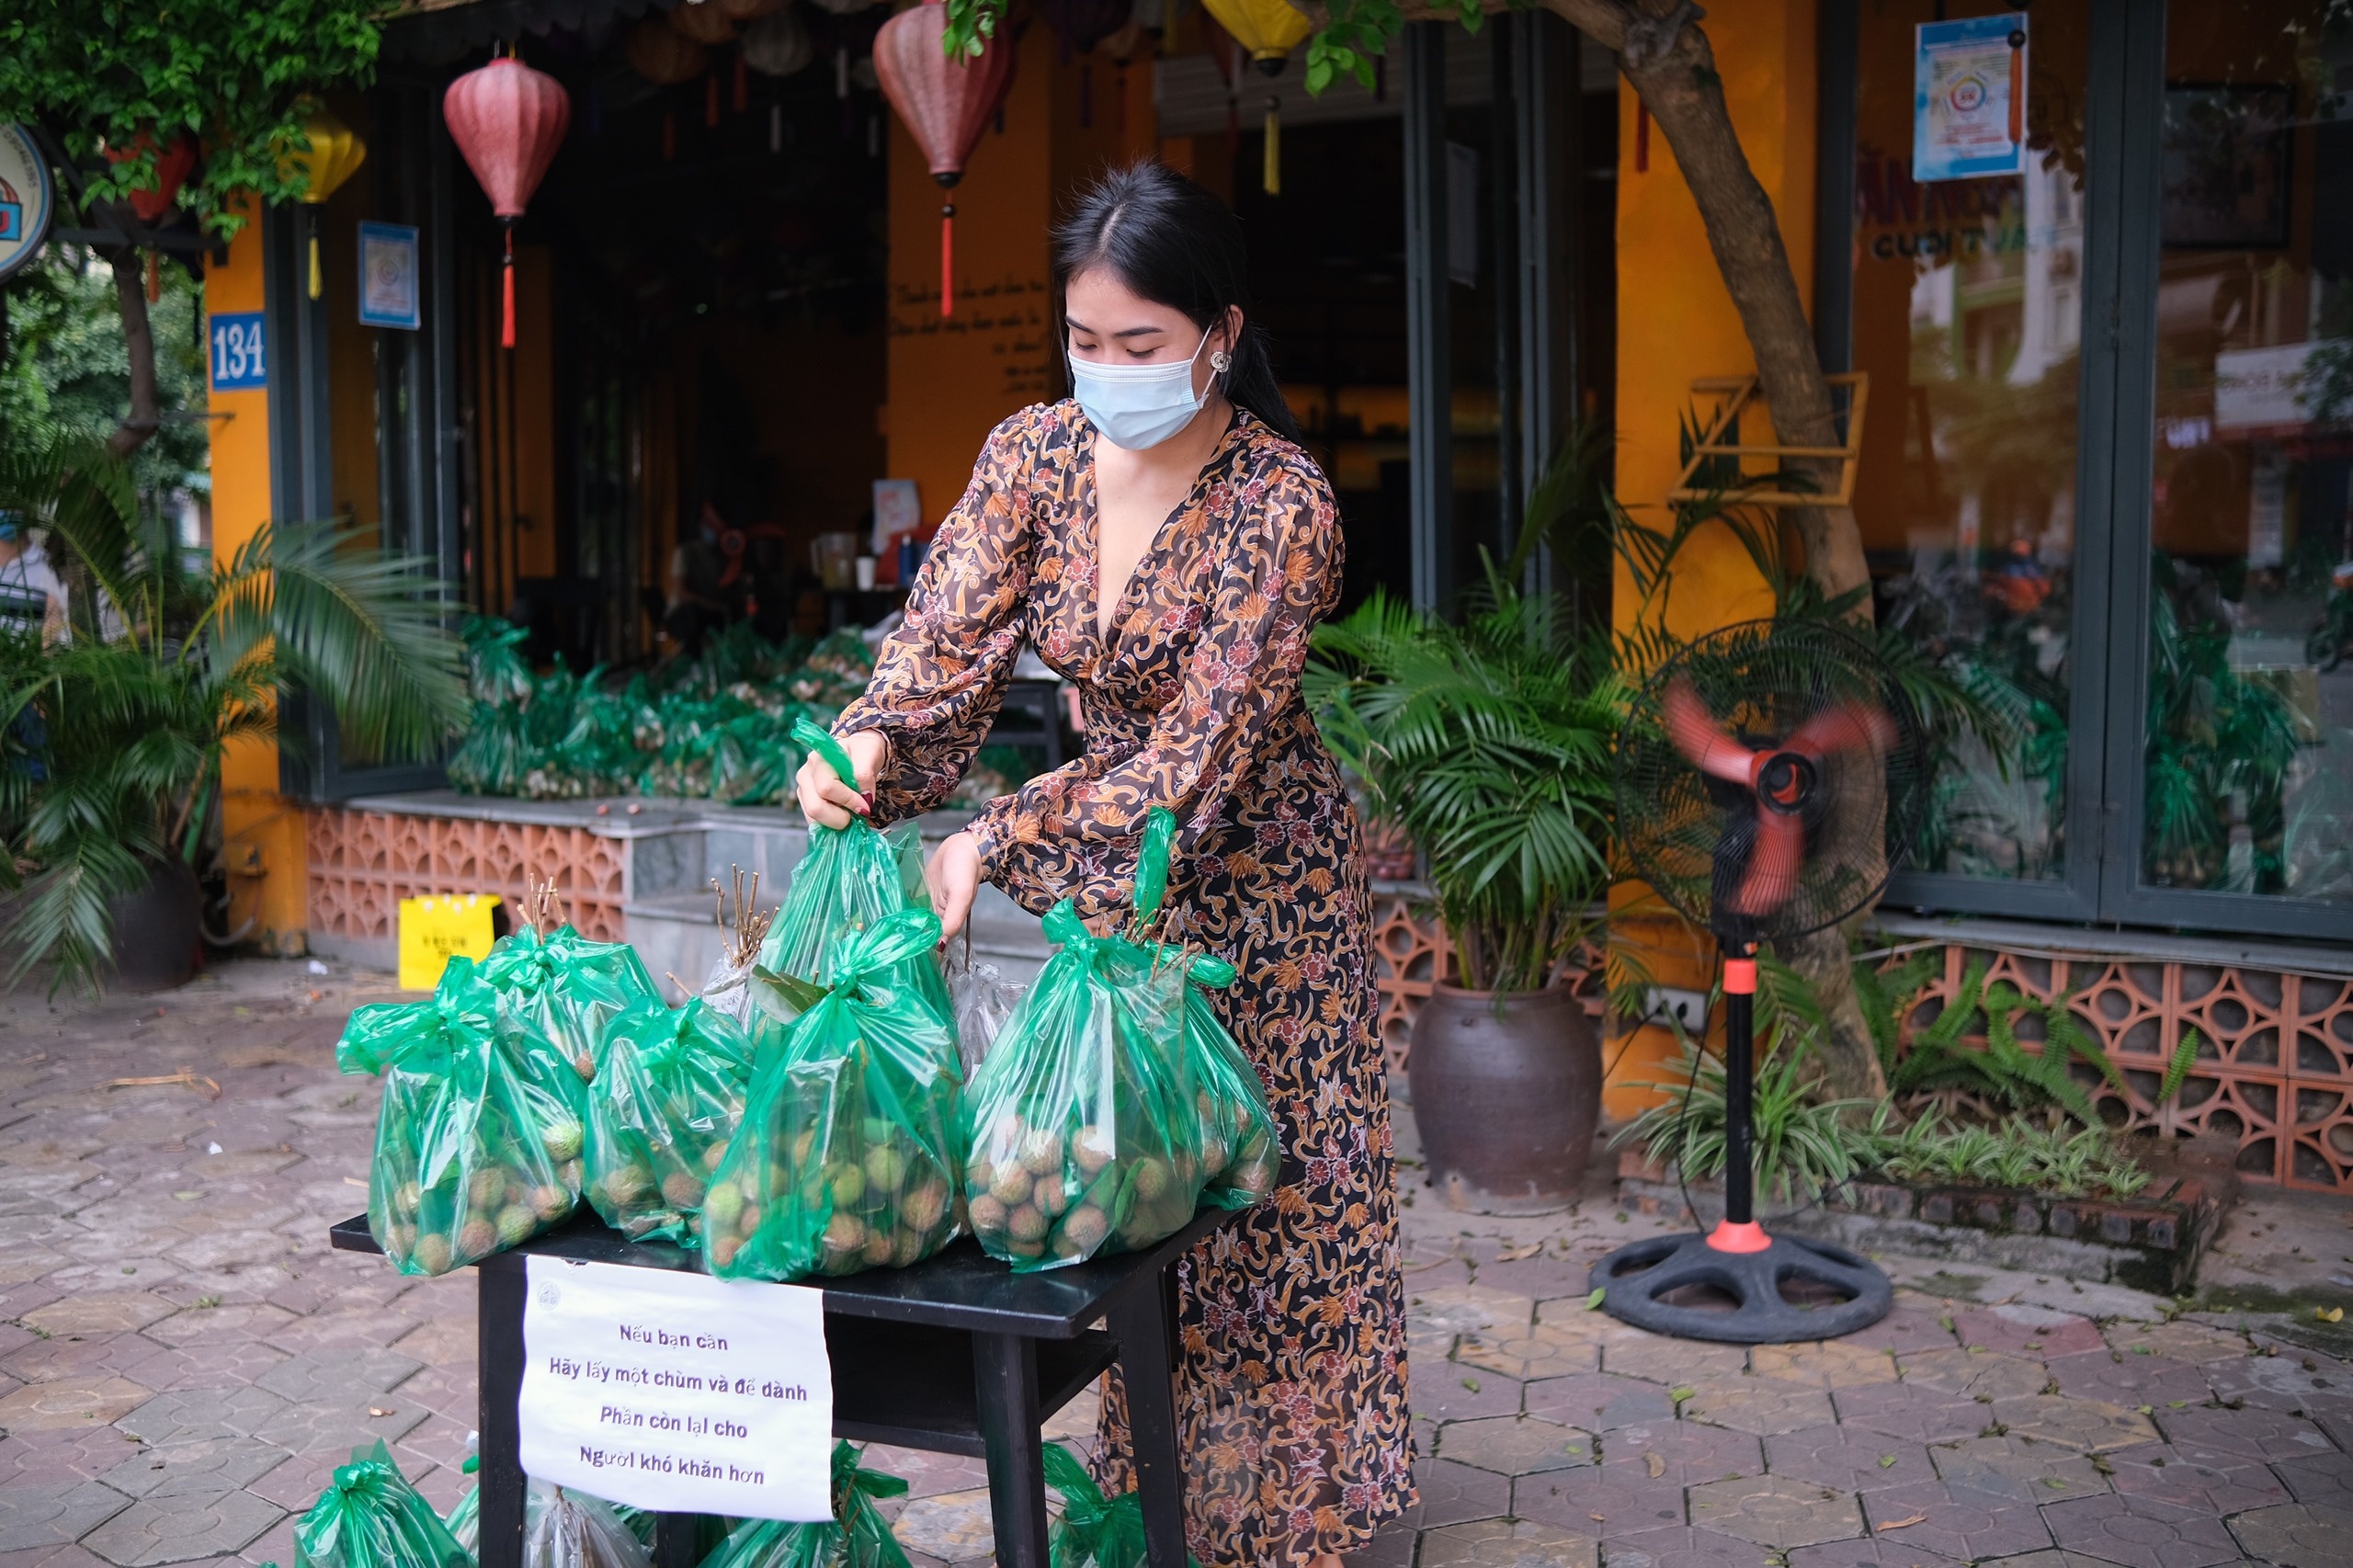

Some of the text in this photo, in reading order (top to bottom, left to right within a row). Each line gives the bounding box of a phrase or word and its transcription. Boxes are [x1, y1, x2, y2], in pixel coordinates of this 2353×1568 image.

[213, 321, 266, 381] 134
[620, 1324, 728, 1350] Nếu bạn cần
[550, 1358, 581, 1380] Hãy
[586, 1360, 610, 1382] lấy
[615, 1367, 649, 1387] một
[654, 1369, 702, 1390] chùm
[709, 1374, 729, 1392] và
[761, 1381, 807, 1401] dành
[600, 1405, 643, 1426] Phần
[649, 1411, 681, 1431] còn
[714, 1420, 747, 1438] cho
[640, 1453, 673, 1472] khó
[678, 1459, 722, 1480] khăn
[729, 1465, 765, 1484] hơn
